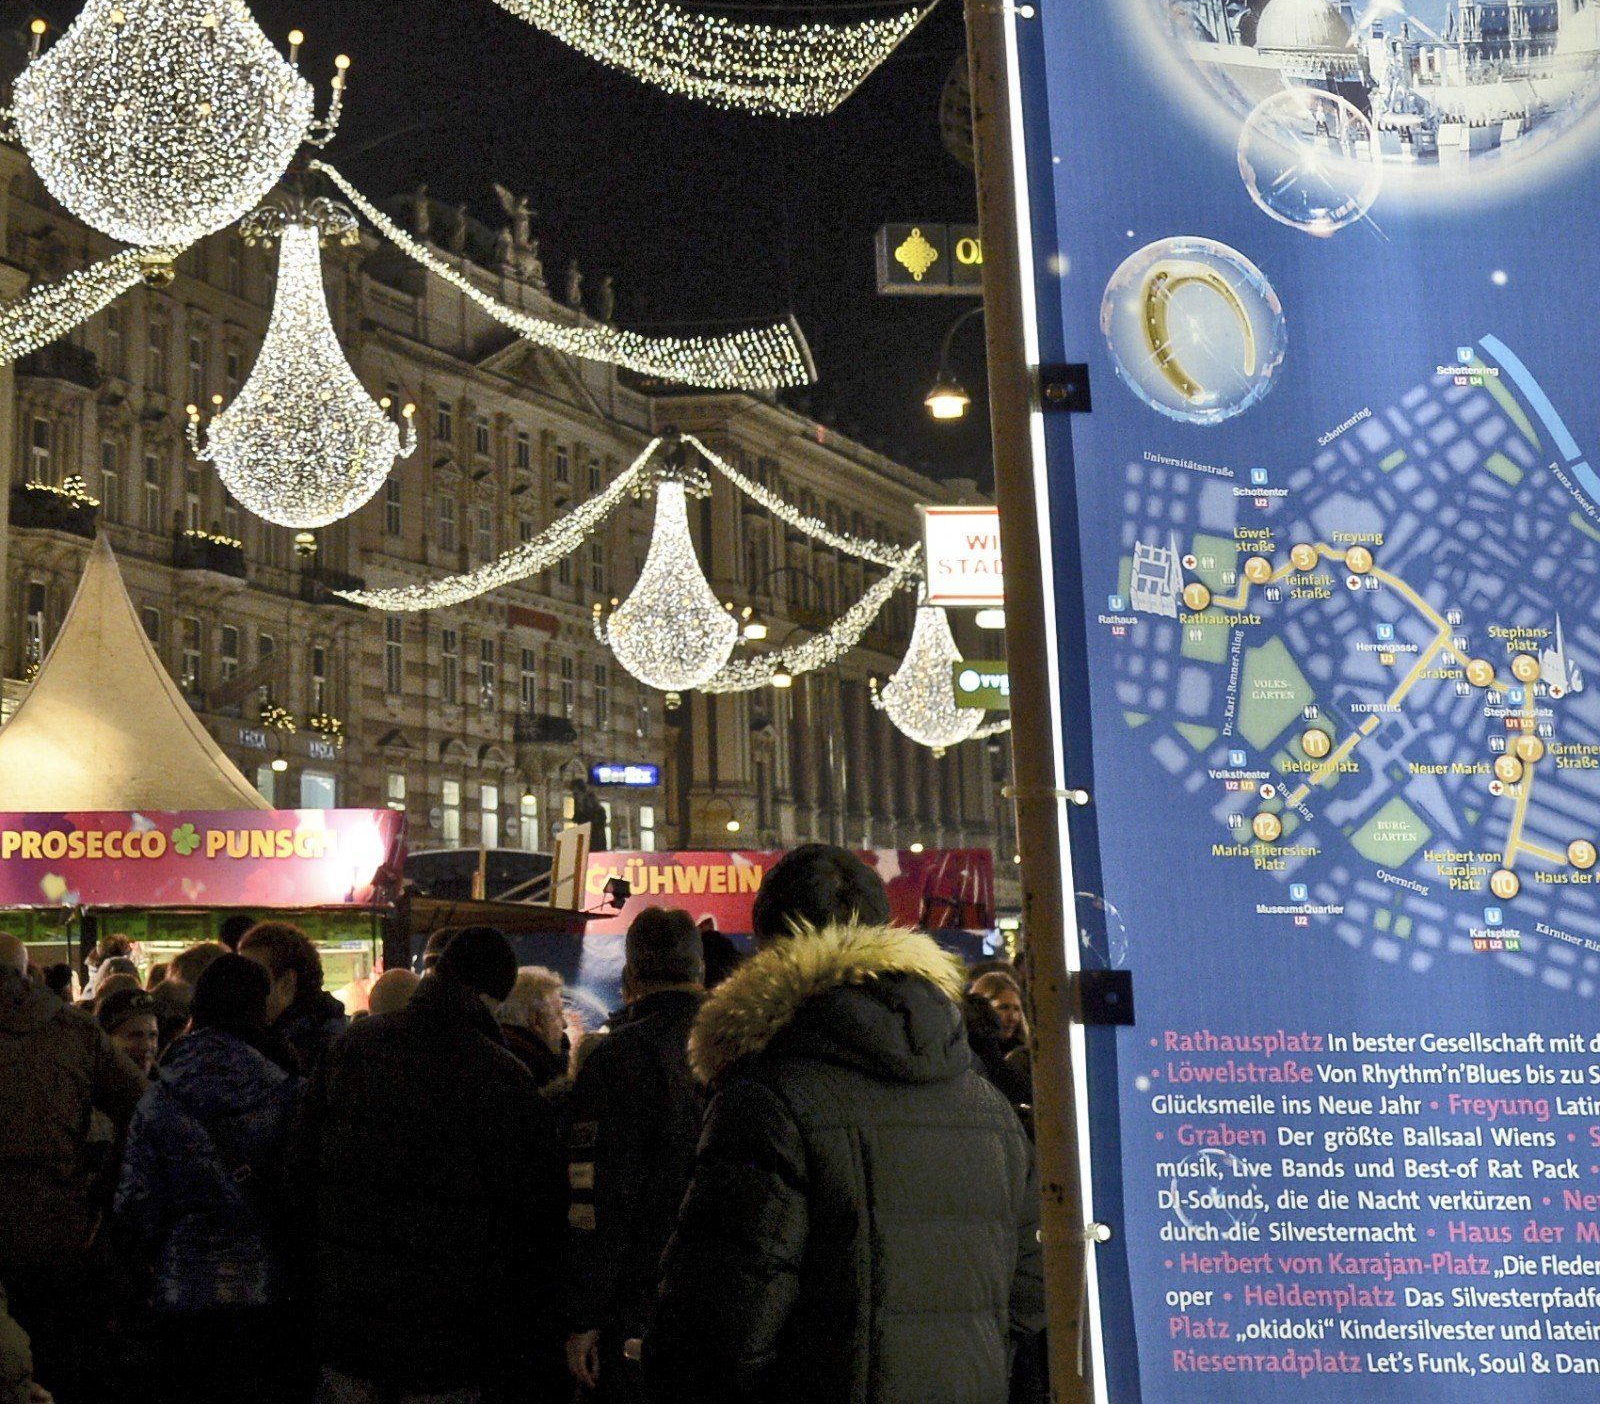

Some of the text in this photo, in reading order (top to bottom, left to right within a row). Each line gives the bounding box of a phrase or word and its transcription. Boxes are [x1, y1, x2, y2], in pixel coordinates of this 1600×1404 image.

[1436, 365, 1499, 377] Schottenring
[1317, 406, 1372, 447] Schottenring
[1143, 451, 1235, 477] Universitätsstraße
[1232, 486, 1289, 497] Schottentor
[1549, 461, 1600, 523] Franz-Josefs-
[1234, 527, 1275, 539] Löwel-
[1332, 531, 1384, 545] Freyung
[1235, 540, 1276, 552] straße
[1290, 588, 1332, 600] straße
[1098, 615, 1138, 625] Rathaus
[1179, 613, 1261, 627] Rathausplatz
[1488, 625, 1553, 639] Stephans-
[1356, 643, 1418, 653] Herrengasse
[1507, 639, 1539, 652] platz
[1253, 679, 1292, 689] VOLKS-
[1252, 690, 1295, 700] GARTEN
[1351, 703, 1402, 713] HOFBURG
[1483, 707, 1553, 718] Stephansplatz
[1547, 741, 1600, 755] Kärntne
[1409, 763, 1491, 774] Neuer Markt
[1555, 755, 1599, 769] Straße
[1208, 770, 1270, 780] Volkstheater
[1377, 821, 1411, 830] BURG-
[1373, 832, 1418, 842] GARTEN
[1, 830, 167, 860] PROSECCO
[206, 830, 339, 859] PUNSCH
[1212, 844, 1322, 858] Maria-Theresien-
[1424, 850, 1502, 863] Herbert von
[1254, 858, 1287, 871] Platz
[586, 858, 763, 895] GÜHWEIN
[1376, 869, 1430, 896] Opernring
[1534, 871, 1592, 884] Haus der
[1449, 878, 1482, 890] Platz
[1256, 904, 1344, 915] MuseumsQuartier
[1469, 928, 1520, 940] Karlsplatz
[1535, 922, 1582, 946] Kärntner
[1164, 1029, 1323, 1058] Rathausplatz
[1328, 1033, 1347, 1052] In
[1352, 1032, 1416, 1052] bester
[1420, 1032, 1545, 1053] Gesellschaft
[1549, 1032, 1586, 1053] mit
[1168, 1060, 1313, 1083] Löwelstraße
[1316, 1064, 1357, 1083] Von
[1526, 1063, 1556, 1084] bis
[1560, 1069, 1585, 1084] zu
[1151, 1093, 1275, 1115] Glücksmeile
[1282, 1095, 1312, 1115] ins
[1318, 1095, 1373, 1115] Neue
[1379, 1094, 1422, 1115] Jahr
[1449, 1093, 1550, 1122] Freyung
[1177, 1123, 1267, 1146] Graben
[1277, 1127, 1315, 1146] Der
[1324, 1126, 1394, 1152] größte
[1403, 1126, 1483, 1147] Ballsaal
[1490, 1126, 1556, 1147] Wiens
[1156, 1157, 1580, 1181] musik, Live Bands und Best-of Rat Pack
[1277, 1189, 1308, 1210] die
[1317, 1189, 1349, 1210] die
[1358, 1189, 1420, 1210] Nacht
[1428, 1190, 1532, 1211] verkürzen
[1563, 1189, 1600, 1212] Ne
[1160, 1221, 1219, 1242] durch
[1228, 1222, 1260, 1242] die
[1268, 1221, 1417, 1243] Silvesternacht
[1449, 1220, 1512, 1243] Haus
[1523, 1219, 1564, 1244] der
[1180, 1251, 1274, 1274] Herbert
[1278, 1257, 1323, 1274] von
[1329, 1251, 1491, 1282] Karajan-Platz
[1494, 1254, 1537, 1279] „Die
[1166, 1290, 1213, 1312] oper
[1244, 1283, 1396, 1313] Heldenplatz
[1404, 1287, 1444, 1308] Das
[1169, 1315, 1231, 1339] Platz
[1340, 1318, 1495, 1340] Kindersilvester
[1500, 1319, 1541, 1341] und
[1173, 1348, 1363, 1379] Riesenradplatz
[1418, 1352, 1475, 1377] Funk,
[1479, 1352, 1526, 1374] Soul
[1531, 1352, 1551, 1374] &
